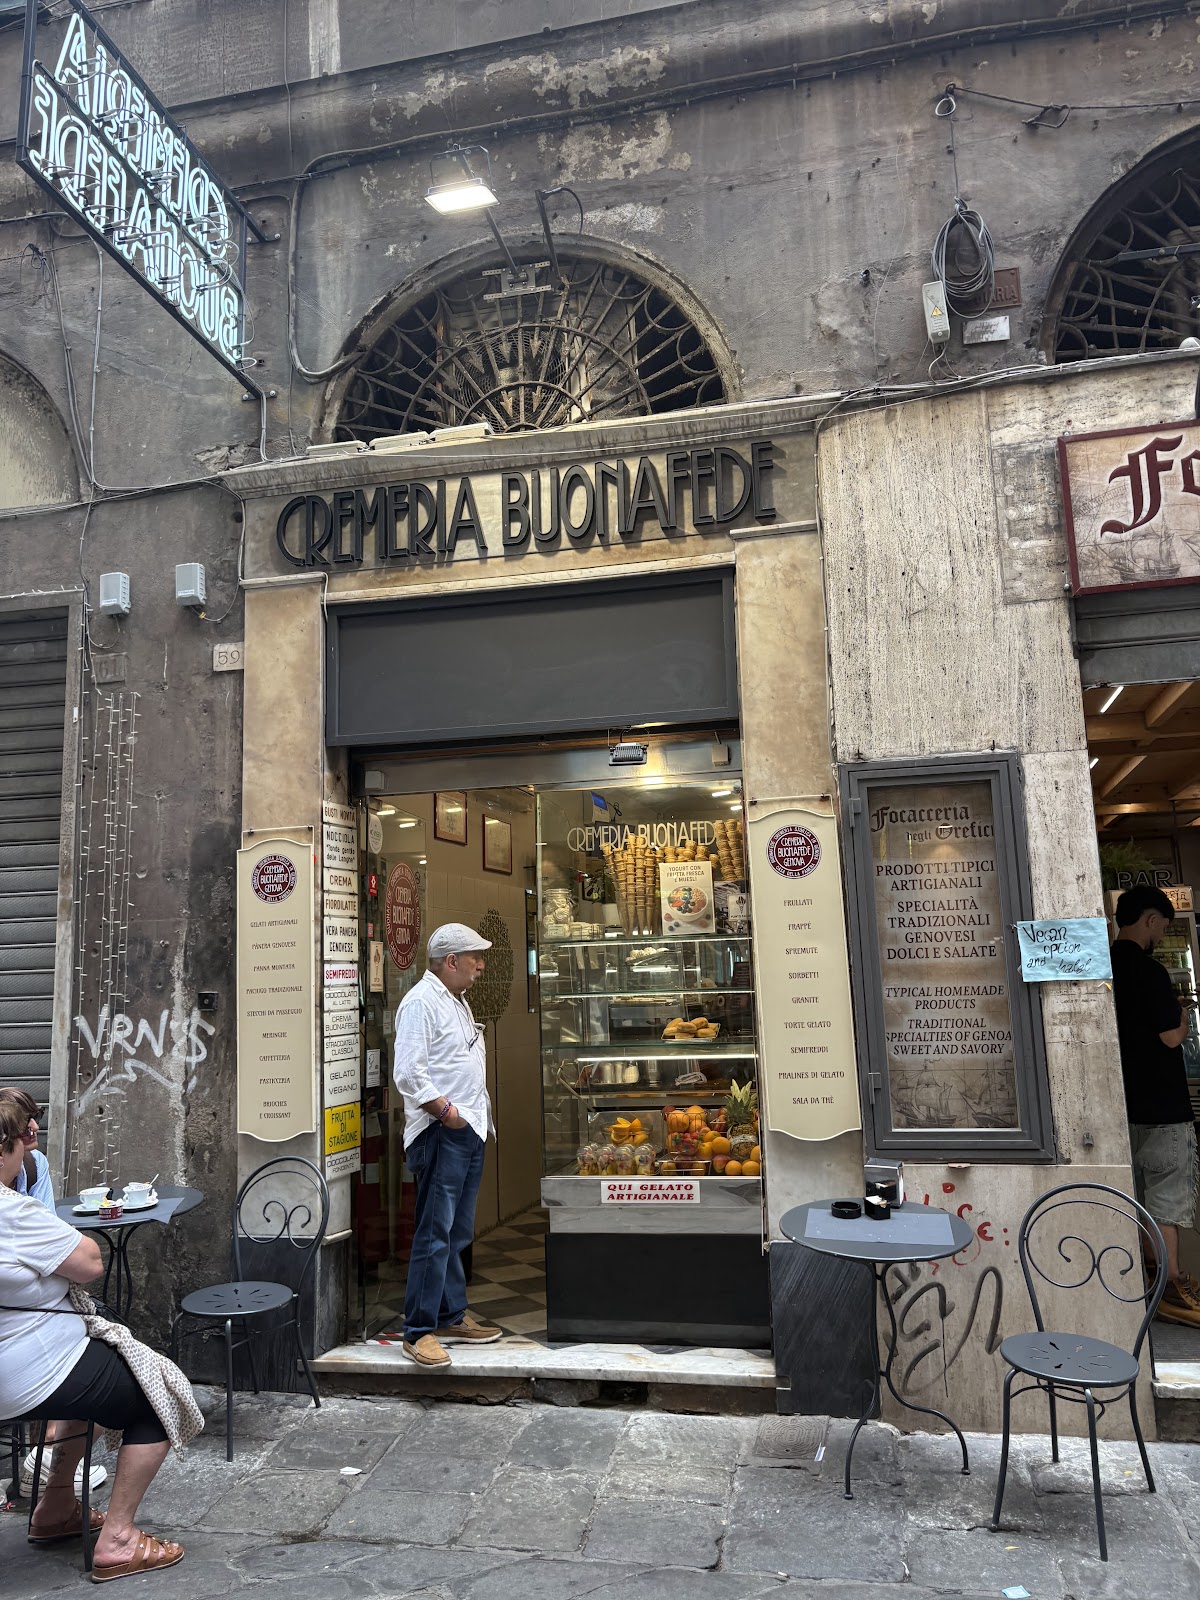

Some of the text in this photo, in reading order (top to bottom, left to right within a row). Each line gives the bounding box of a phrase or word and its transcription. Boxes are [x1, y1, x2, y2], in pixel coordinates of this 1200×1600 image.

[276, 440, 778, 566] CREMERIA BUONAFEDE
[217, 650, 241, 665] 59
[870, 802, 970, 832] Focacceria
[326, 830, 356, 845] NOCCIOLA
[567, 820, 718, 851] CREMERIA BUONAFED
[777, 845, 812, 858] BUONAFEDE
[783, 856, 806, 867] GENOVA
[876, 860, 996, 877] PRODOTTI TIPICI
[329, 874, 353, 888] CREMA
[890, 877, 983, 892] ARTIGIANALI
[1117, 869, 1171, 889] BAR
[325, 898, 357, 912] FIORDILATTE
[897, 896, 979, 913] SPECIALITÀ
[887, 914, 991, 928] TRADIZIONALI
[325, 925, 338, 937] VERA
[339, 926, 357, 938] PANERA
[905, 930, 976, 944] GENOVESI
[1022, 923, 1068, 943] Vegan
[329, 941, 354, 953] GENOVESE
[785, 947, 818, 955] SPREMUTE
[887, 946, 997, 960] DOLCI E SALATE
[1026, 956, 1047, 969] and
[325, 969, 359, 980] SEMIFREDDI
[788, 971, 819, 979] SORBETTI
[885, 985, 1005, 998] TYPICAL HOMEMADE
[791, 996, 819, 1004] GRANITE
[914, 998, 976, 1010] PRODUCTS
[331, 1014, 353, 1023] CREMA
[784, 1020, 832, 1029] TORTE GELATO
[907, 1018, 987, 1029] TRADITIONAL
[885, 1030, 1013, 1043] SPECIALTIES OF GENOA
[331, 1046, 354, 1058] CLASSICA
[790, 1046, 829, 1054] SEMIFREDDI
[893, 1043, 1006, 1056] SWEET AND SAVORY
[259, 1077, 291, 1085] PASTICCERIA
[329, 1068, 356, 1081] GELATO
[778, 1070, 845, 1079] PRALINES DI GELATO
[328, 1082, 358, 1096] VEGANO
[792, 1097, 809, 1105] SALA
[810, 1096, 820, 1104] DA
[263, 1111, 291, 1119] CROISSANT
[331, 1109, 355, 1124] FRUTTA
[340, 1122, 347, 1133] DI
[328, 1130, 358, 1148] STAGIONE
[639, 1183, 694, 1191] GELATO
